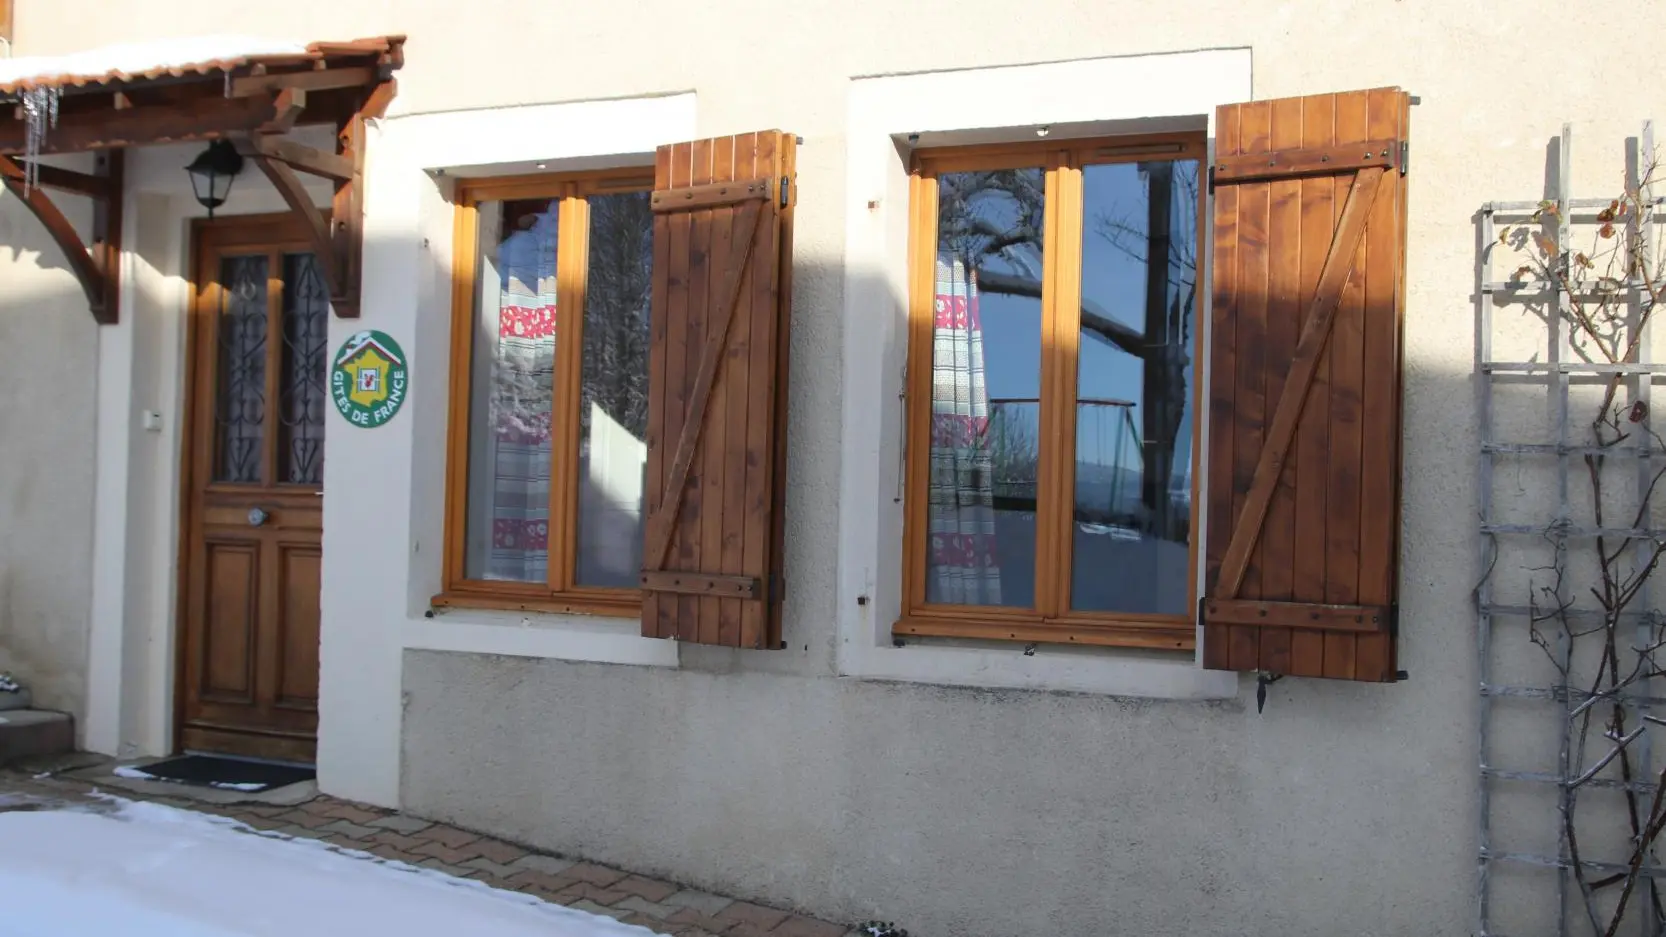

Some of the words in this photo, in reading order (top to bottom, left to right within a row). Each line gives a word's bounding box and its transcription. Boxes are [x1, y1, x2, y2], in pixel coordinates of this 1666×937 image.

[333, 371, 351, 413] GITES
[352, 410, 369, 424] DE
[374, 370, 404, 423] FRANCE
